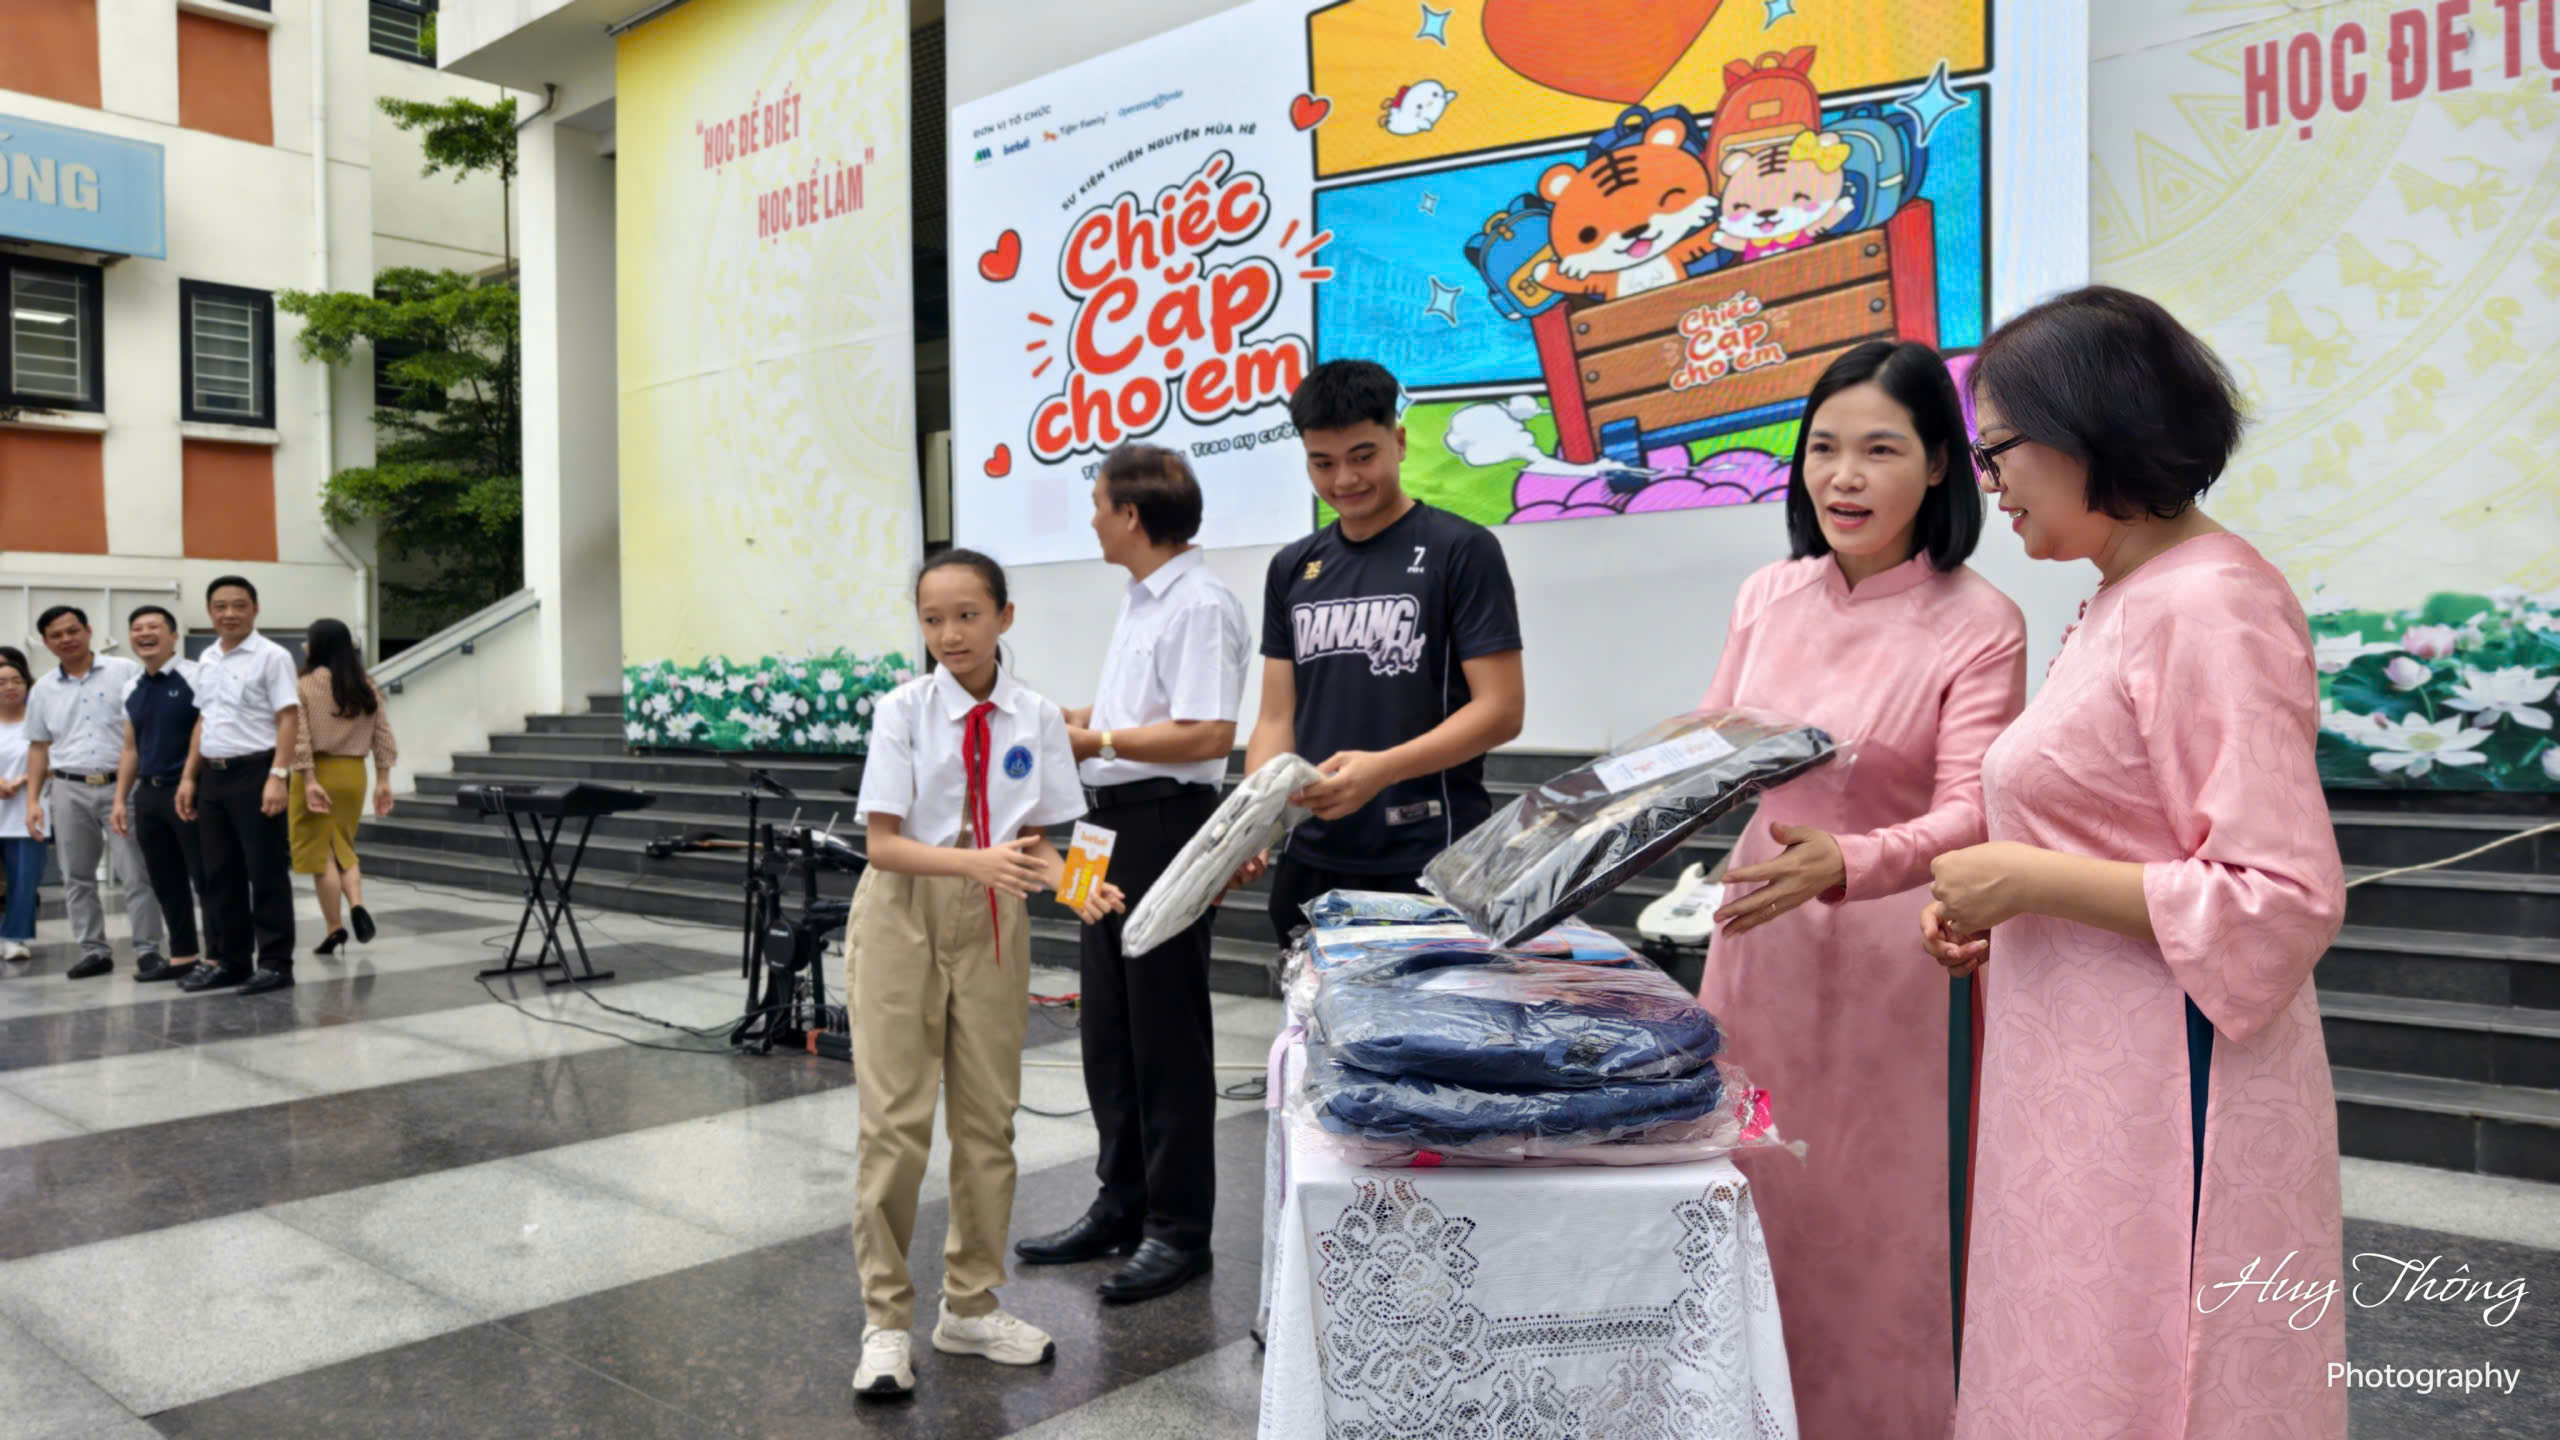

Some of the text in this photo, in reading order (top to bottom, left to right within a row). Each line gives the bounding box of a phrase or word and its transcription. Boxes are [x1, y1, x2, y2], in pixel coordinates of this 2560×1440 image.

[2244, 22, 2367, 141] HỌC
[764, 81, 801, 148] BIẾT
[1062, 194, 1076, 211] SỰ
[1079, 172, 1105, 195] KIỆN
[1109, 148, 1144, 172] THIỆN
[1148, 126, 1200, 152] NGUYỆN
[1205, 123, 1233, 137] MÙA
[758, 187, 791, 244] HỌC
[1066, 159, 1260, 290] Chiếc
[1076, 262, 1270, 375] Cặp
[1681, 291, 1759, 335] Chiếc
[1688, 322, 1766, 361] Cặp
[1672, 345, 1782, 389] cho em
[1036, 344, 1303, 453] cho em
[1191, 438, 1231, 457] Trao
[1258, 421, 1298, 443] cườ
[1413, 546, 1425, 566] 7
[1293, 598, 1418, 660] DANANG
